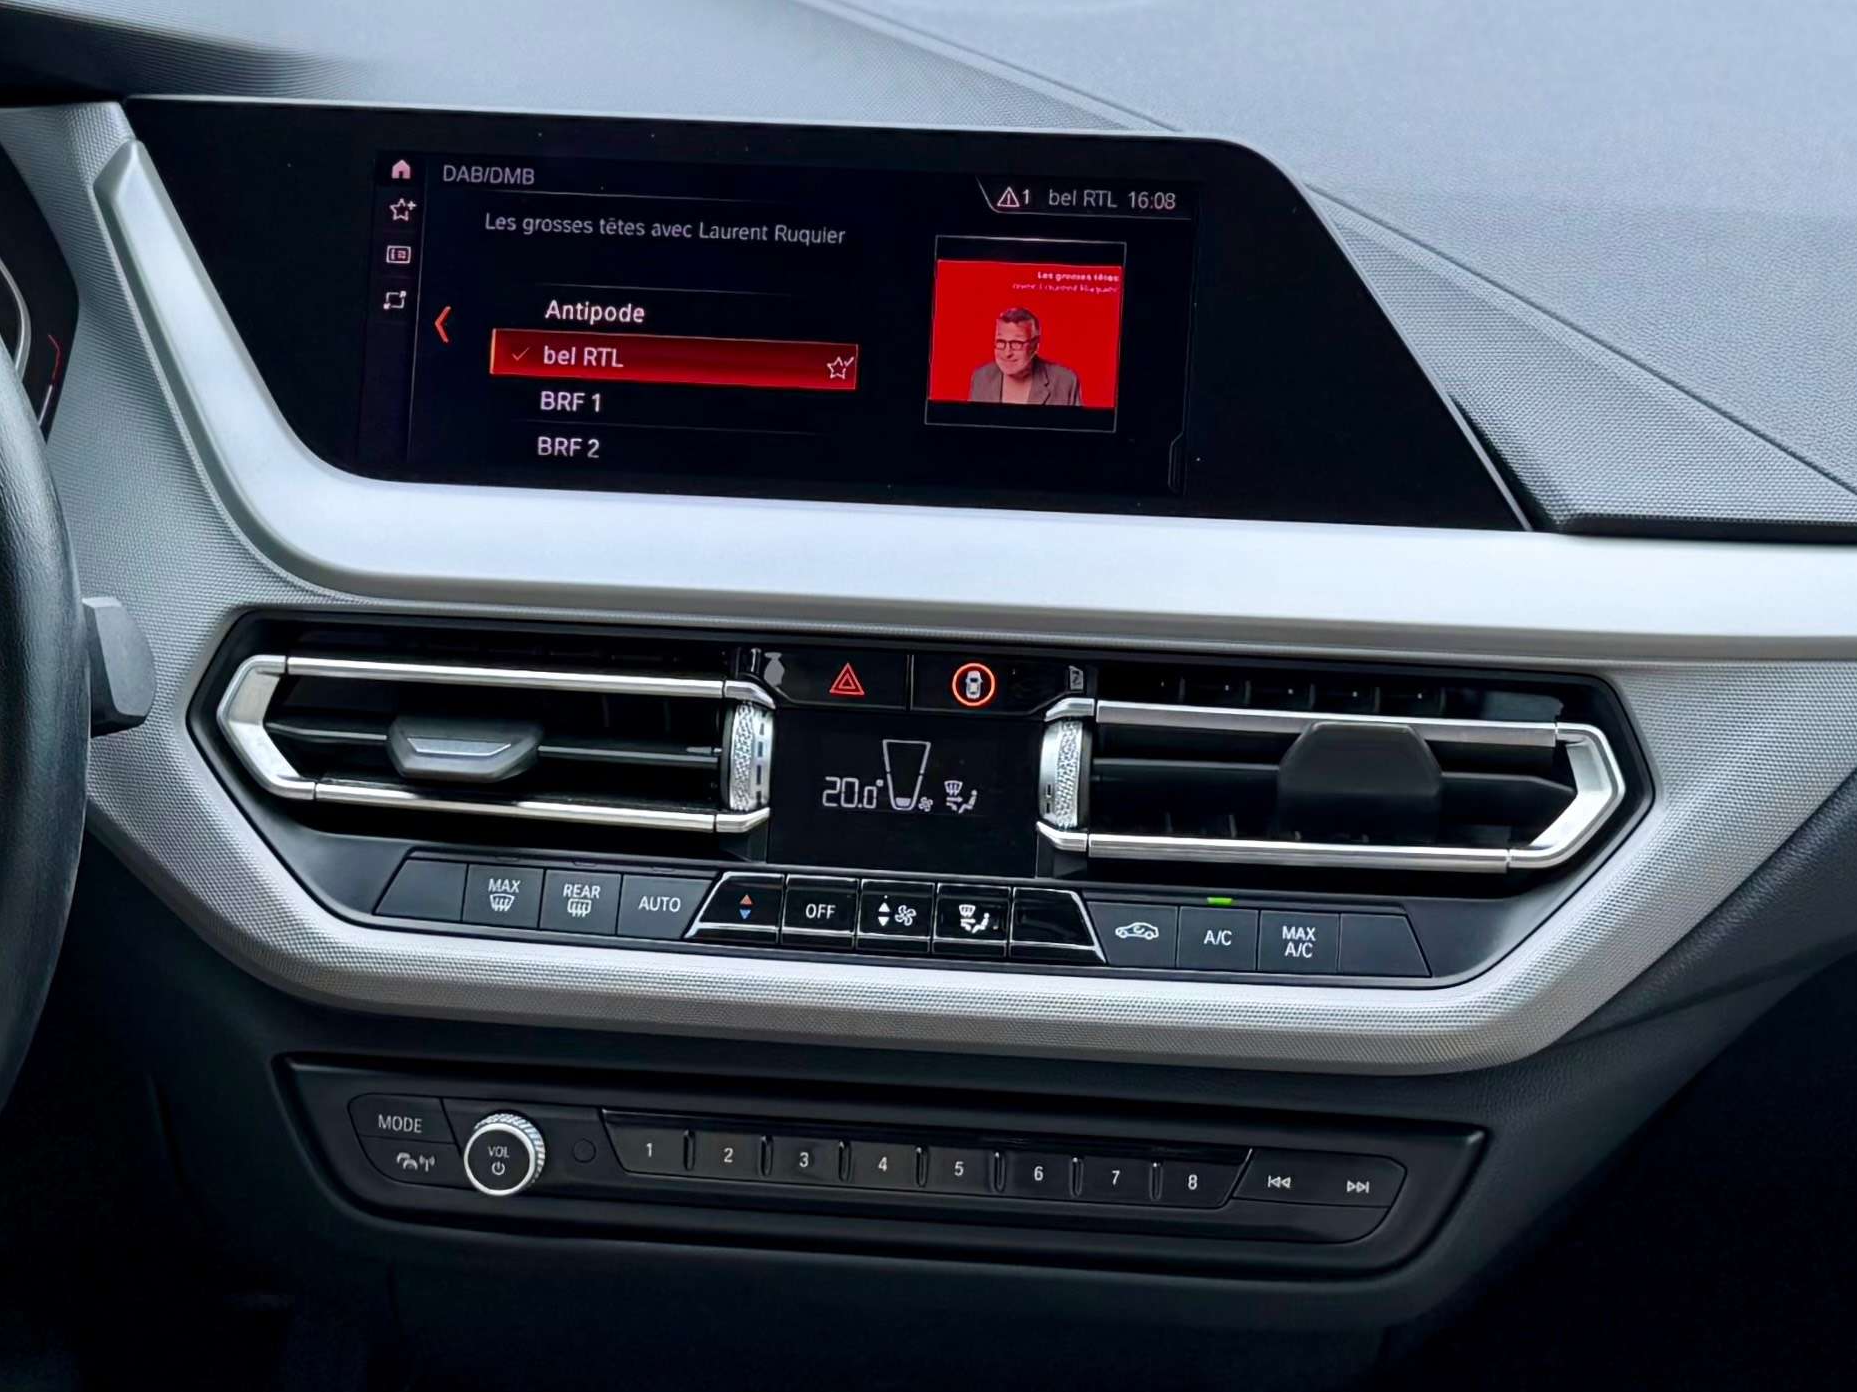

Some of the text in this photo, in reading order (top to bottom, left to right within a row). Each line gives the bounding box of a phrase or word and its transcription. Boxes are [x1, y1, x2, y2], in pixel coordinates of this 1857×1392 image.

[443, 165, 535, 185] DAB/DMB
[1022, 189, 1177, 210] 1 bel RTL 16:08
[485, 212, 517, 232] Les
[523, 217, 593, 238] grosses
[651, 222, 693, 239] avec
[699, 220, 768, 241] Laurent
[774, 224, 846, 247] Ruquier
[545, 300, 645, 326] Antipode
[543, 346, 624, 369] bel RTL
[540, 391, 602, 413] BRF 1
[537, 436, 600, 459] BRF 2
[488, 877, 521, 894] MAX
[562, 882, 601, 900] REAR
[638, 895, 681, 913] AUTO
[805, 903, 836, 920] OFF
[1203, 928, 1232, 947] A/C
[1282, 925, 1317, 941] MAX
[1284, 942, 1313, 959] A/C
[378, 1114, 423, 1133] MODE
[487, 1144, 510, 1159] VOL
[645, 1142, 654, 1159] 1
[723, 1147, 734, 1164] 2
[799, 1151, 810, 1169] 3
[877, 1155, 889, 1172] 4
[954, 1160, 964, 1177] 5
[1033, 1165, 1044, 1182] 6
[1111, 1169, 1121, 1186] 7
[1187, 1174, 1198, 1191] 8
